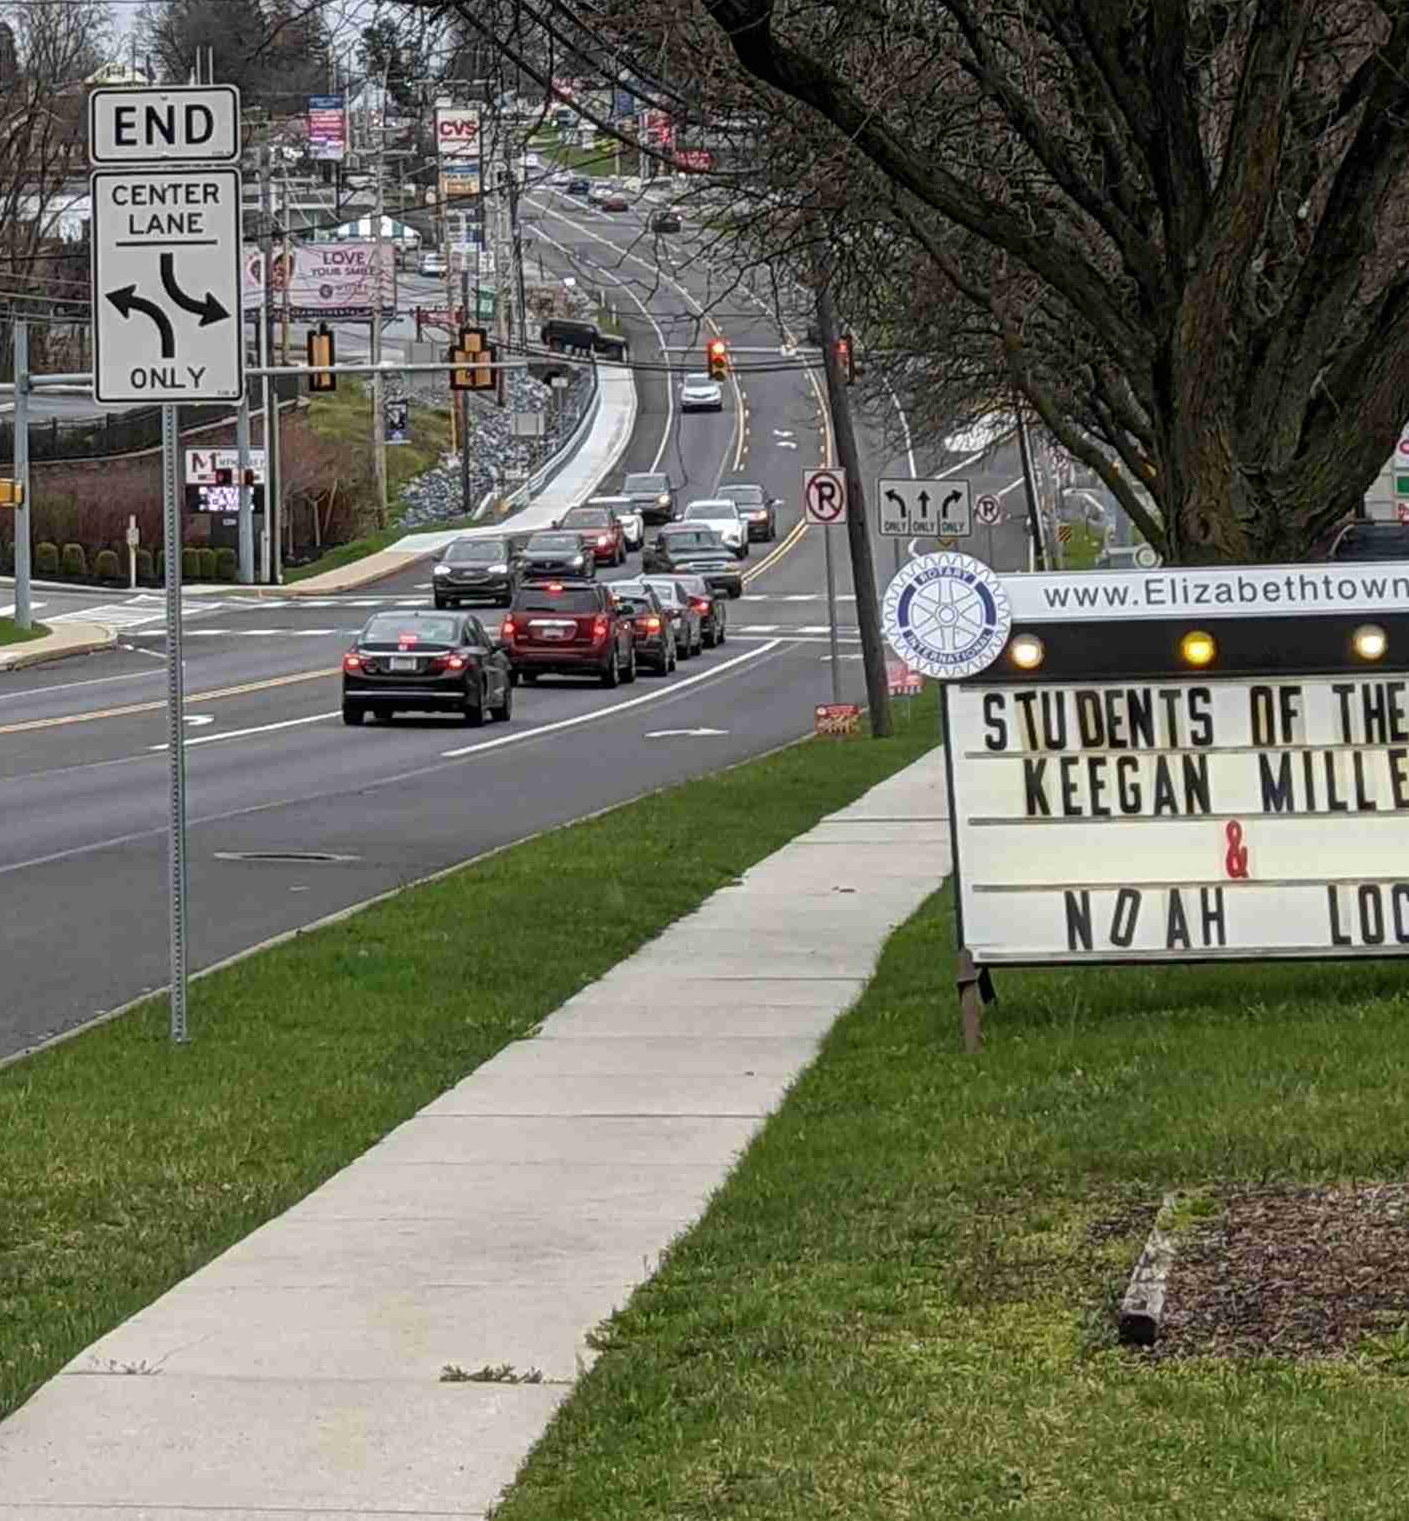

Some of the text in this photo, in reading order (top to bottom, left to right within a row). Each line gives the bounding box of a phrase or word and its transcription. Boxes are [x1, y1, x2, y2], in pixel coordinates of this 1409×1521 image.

[114, 103, 214, 146] END
[440, 119, 478, 137] CVS
[112, 182, 220, 206] CENTER
[129, 212, 203, 235] LANE
[323, 251, 365, 265] LOVE
[311, 266, 376, 277] YOUR SMILE
[130, 367, 206, 389] ONLY
[884, 521, 965, 533] ONLY ONLY ONLY
[918, 566, 977, 585] ROTARY
[904, 630, 993, 665] INTERNATIONAL
[983, 682, 1409, 752] STUDENTS OF THE
[1023, 755, 1212, 816] KEEGAN
[1224, 819, 1249, 879] &
[1065, 887, 1227, 951] NOAH
